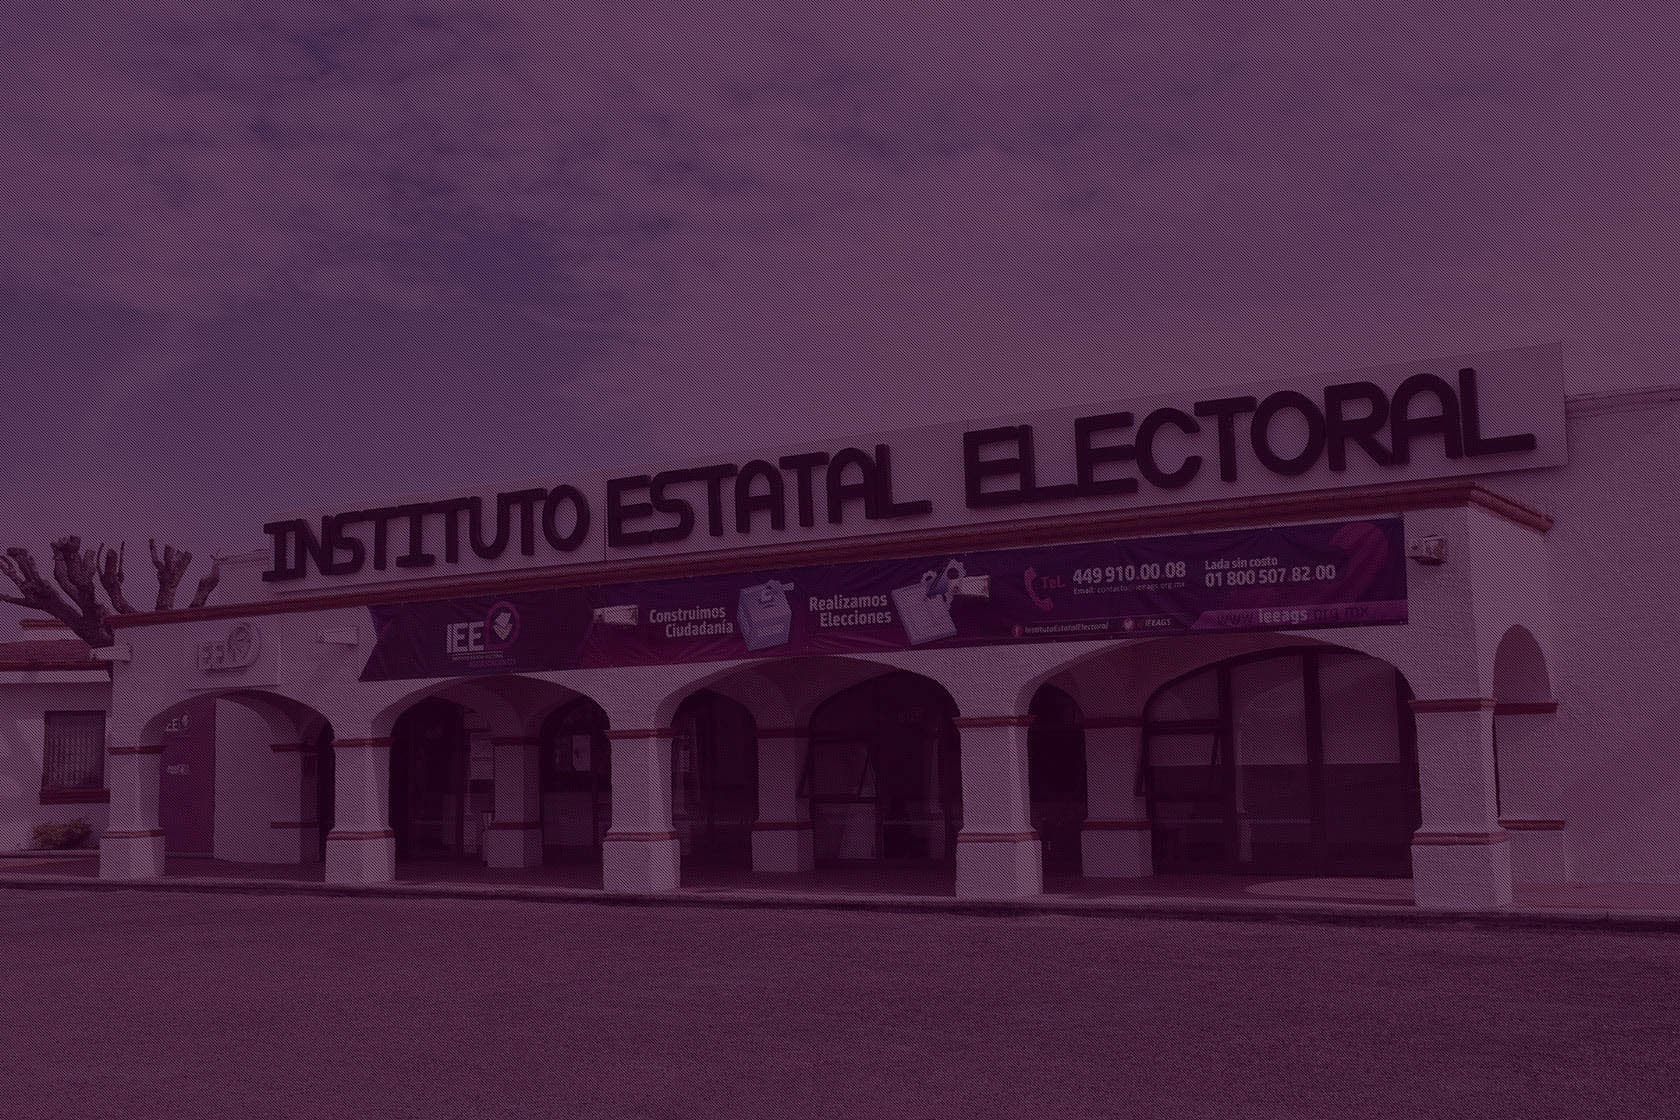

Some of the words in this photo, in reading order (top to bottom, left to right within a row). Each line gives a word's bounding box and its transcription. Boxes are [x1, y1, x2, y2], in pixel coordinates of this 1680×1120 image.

[262, 484, 590, 582] INSTITUTO
[606, 444, 933, 547] ESTATAL
[963, 367, 1536, 508] ELECTORAL
[1204, 559, 1230, 571] Lada
[1231, 557, 1248, 569] sin
[1249, 556, 1279, 568] costo
[1072, 567, 1102, 585] 449
[1204, 571, 1223, 588] 01
[1226, 569, 1256, 586] 800
[808, 593, 888, 613] Realizamos
[649, 605, 727, 625] Construimos
[819, 610, 893, 628] Elecciones
[446, 621, 485, 654] IEE
[664, 620, 735, 639] Ciudadanía
